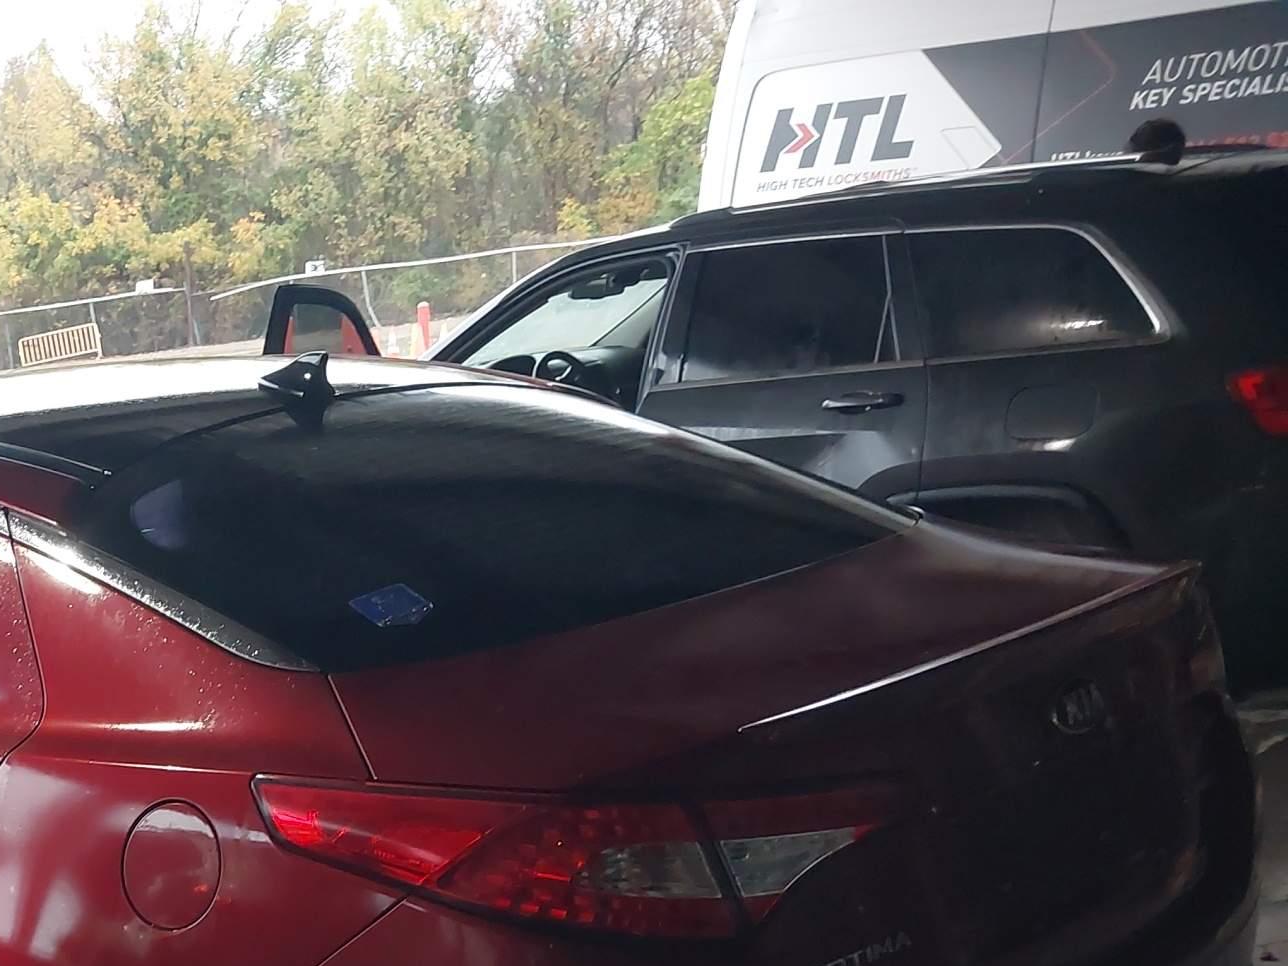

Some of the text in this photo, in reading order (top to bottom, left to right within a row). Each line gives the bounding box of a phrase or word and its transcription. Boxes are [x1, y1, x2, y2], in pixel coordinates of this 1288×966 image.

[1142, 41, 1288, 85] AUTOMOT
[1129, 87, 1176, 111] KEY
[760, 94, 914, 173] HTL
[757, 167, 912, 192] HIGH TECH LOCKSMITHS
